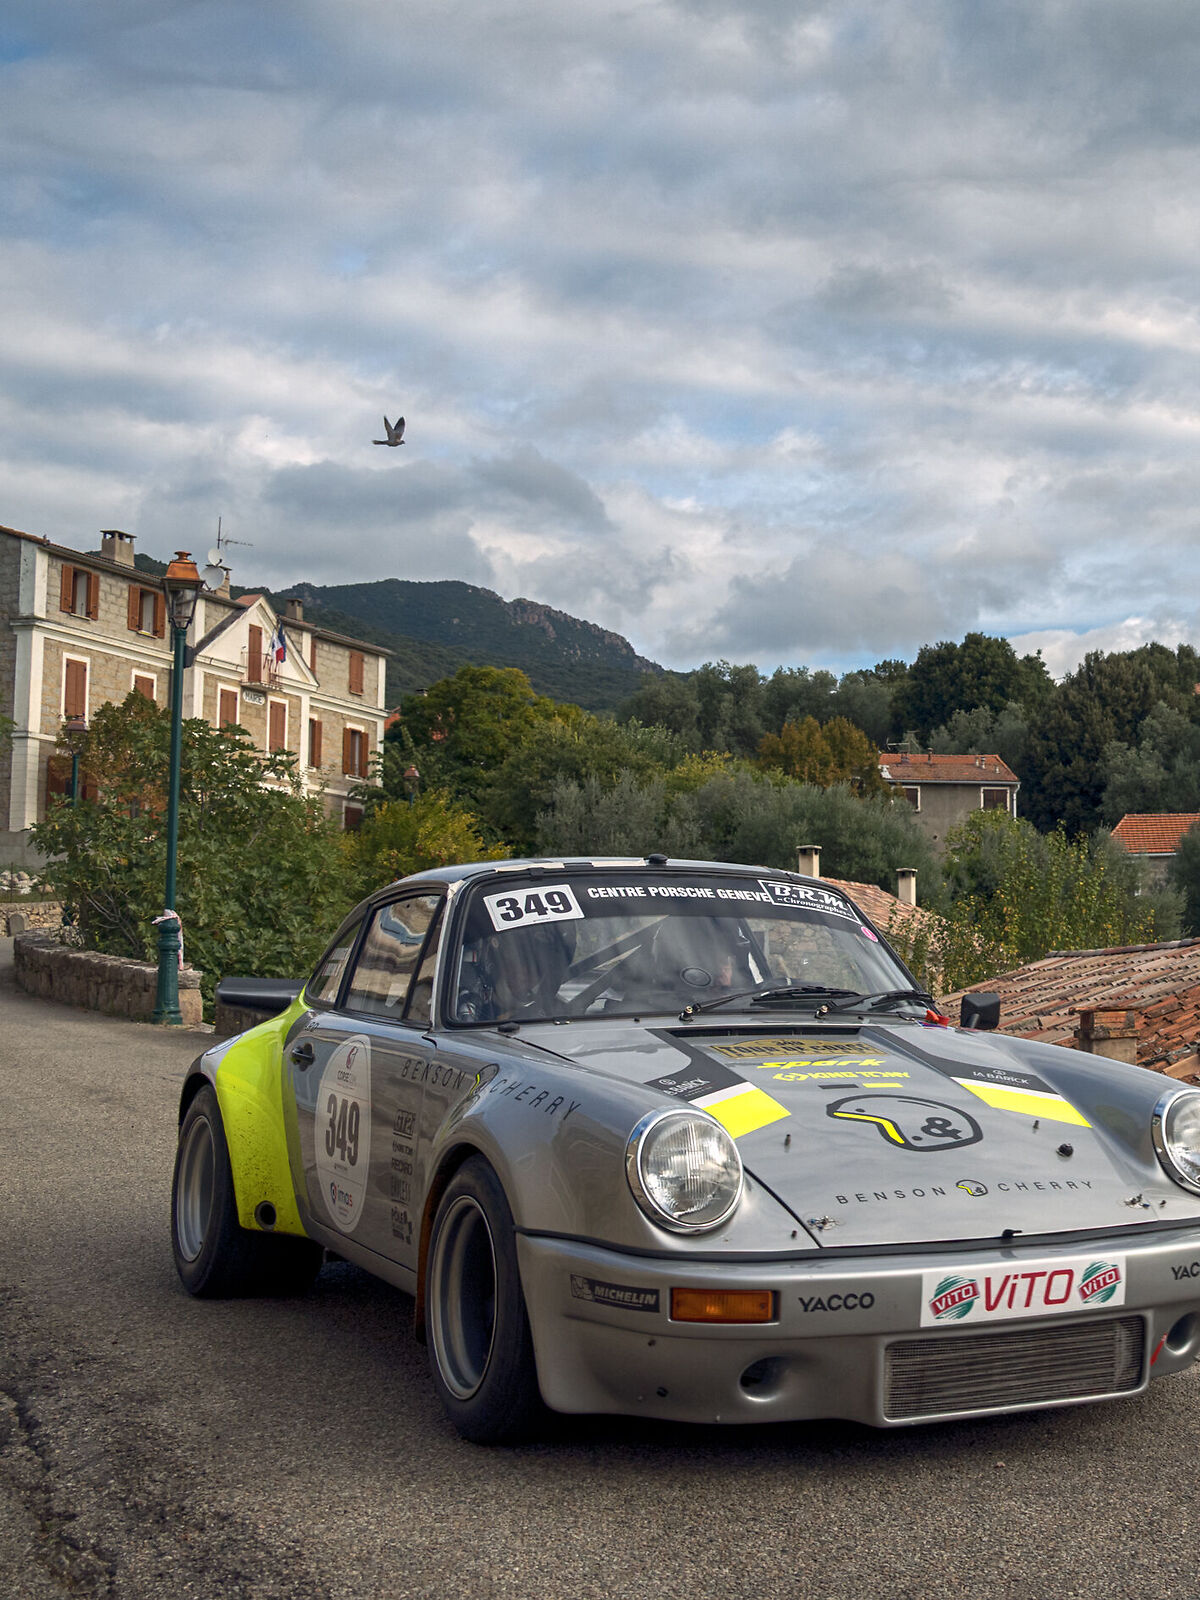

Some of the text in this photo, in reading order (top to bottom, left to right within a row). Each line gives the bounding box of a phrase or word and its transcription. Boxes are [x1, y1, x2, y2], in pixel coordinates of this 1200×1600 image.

[245, 691, 263, 704] MAIRIE
[496, 891, 573, 921] 349
[587, 886, 770, 903] CENTRE PORSCHE GENEVE
[756, 1058, 886, 1070] spark
[400, 1058, 581, 1121] BENSON CHERRY
[326, 1093, 360, 1166] 349
[835, 1185, 946, 1205] BENSON
[997, 1180, 1094, 1193] CHERRY
[594, 1285, 657, 1305] MICHELIN
[797, 1291, 876, 1314] YACCO
